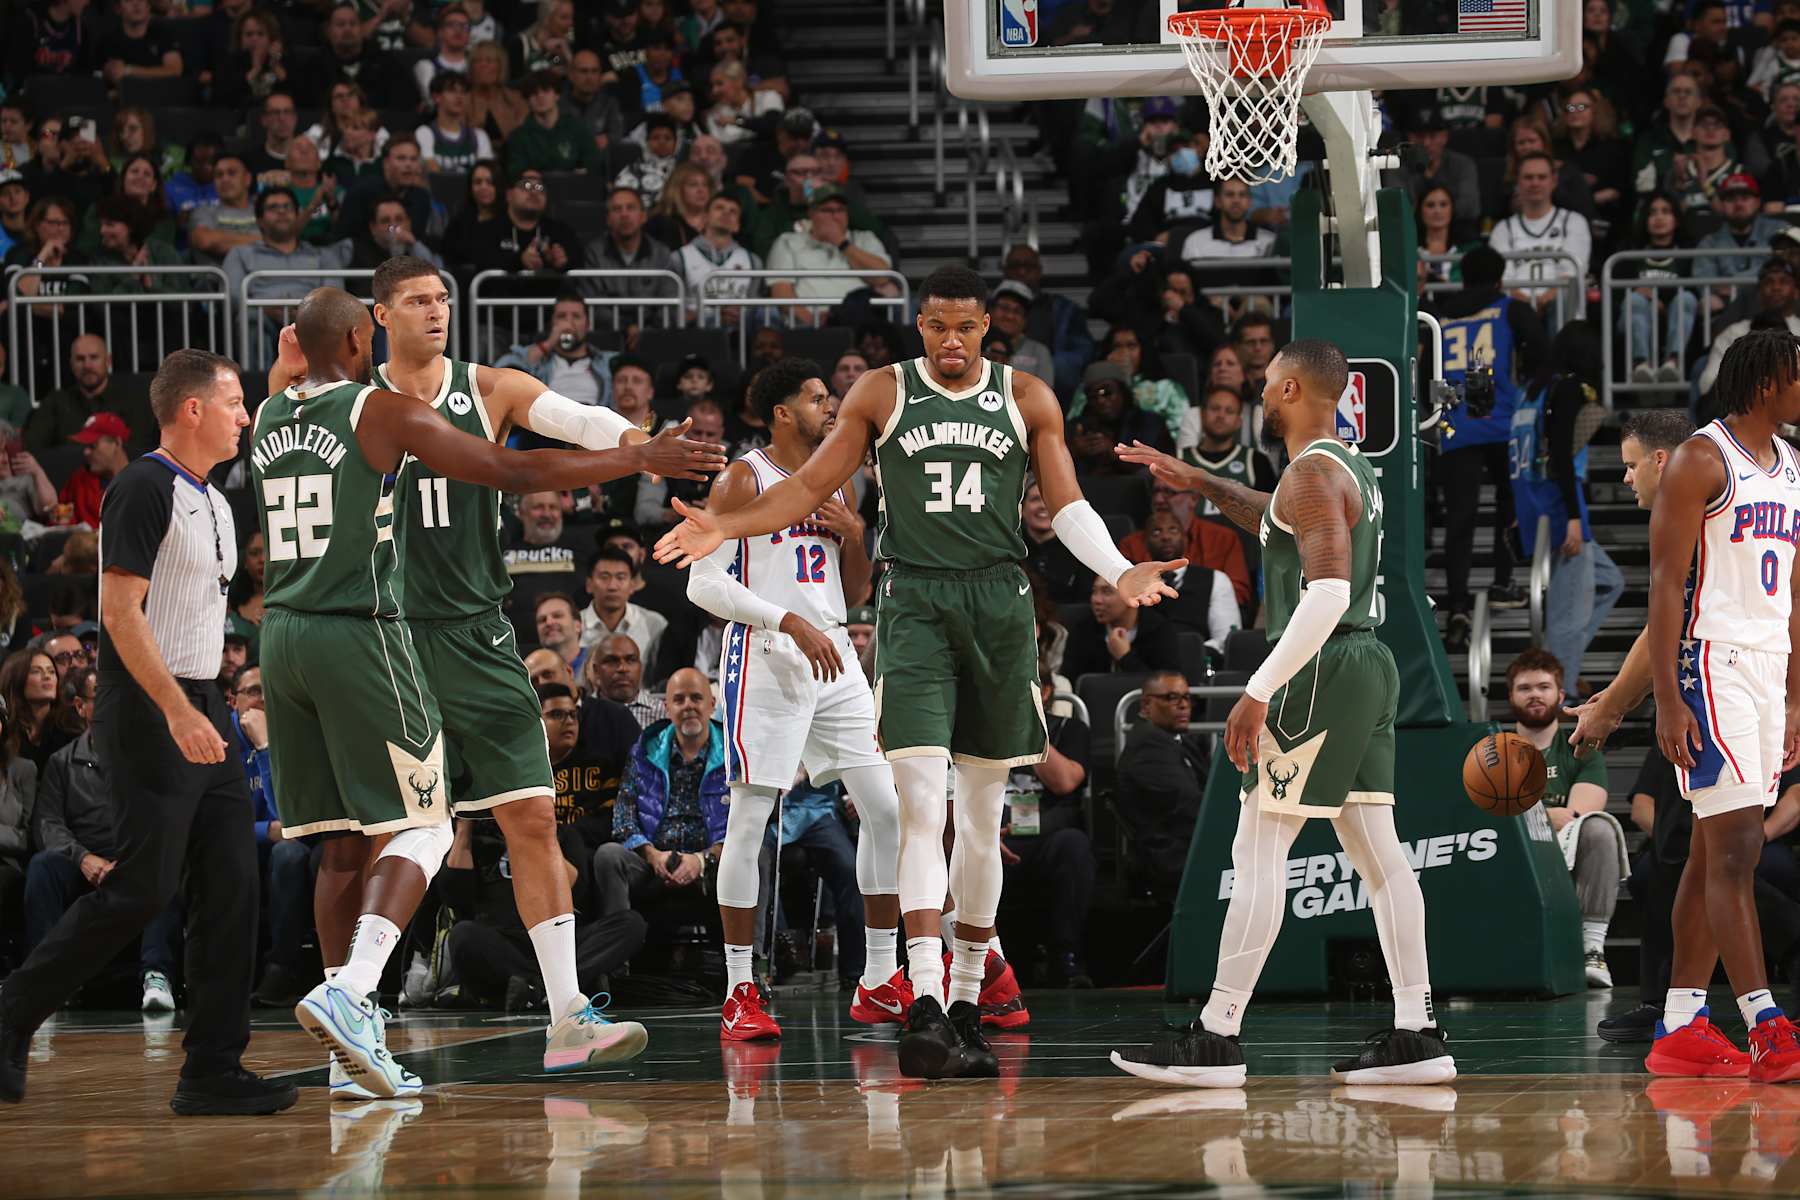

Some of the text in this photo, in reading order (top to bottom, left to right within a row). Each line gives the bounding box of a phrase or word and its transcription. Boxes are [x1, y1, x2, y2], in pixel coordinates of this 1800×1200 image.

[1006, 27, 1024, 41] NBA
[1443, 321, 1496, 371] 34
[251, 423, 348, 475] MIDDLETON
[898, 421, 1015, 461] MILWAUKEE
[1338, 426, 1355, 439] NBA
[417, 477, 451, 528] 11
[924, 461, 986, 513] 34
[262, 473, 333, 562] 22
[795, 544, 827, 583] 12
[1761, 549, 1779, 597] 0
